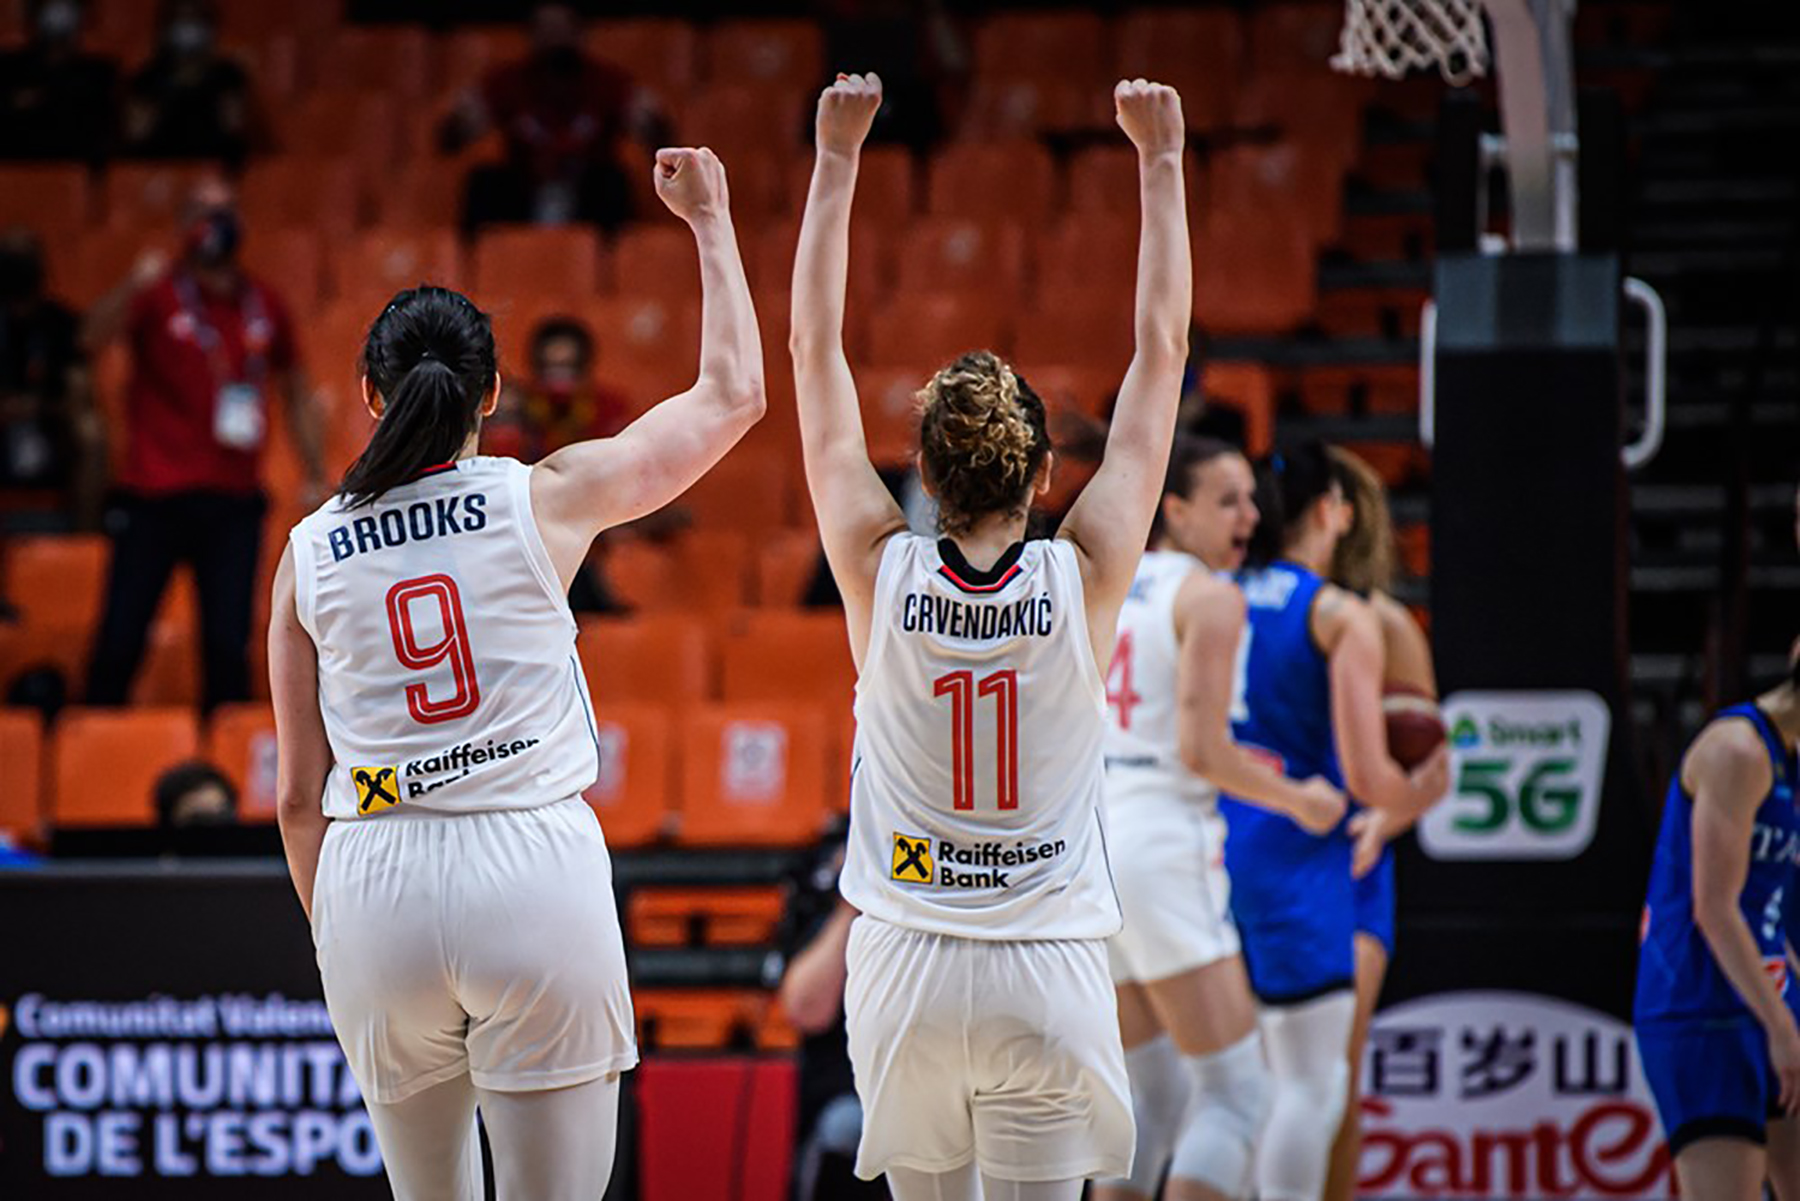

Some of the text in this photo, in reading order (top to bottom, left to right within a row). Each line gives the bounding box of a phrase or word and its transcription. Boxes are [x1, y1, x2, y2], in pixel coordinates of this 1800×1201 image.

[328, 494, 487, 562] BROOKS
[385, 573, 480, 725] 9
[903, 592, 1052, 640] CRVENDAKIĆ
[933, 669, 1018, 810] 11
[1453, 759, 1582, 834] 5G
[938, 839, 1066, 866] Raiffeisen
[940, 866, 1009, 888] Bank
[1373, 1024, 1628, 1098] 百岁山
[44, 1111, 142, 1176] DE
